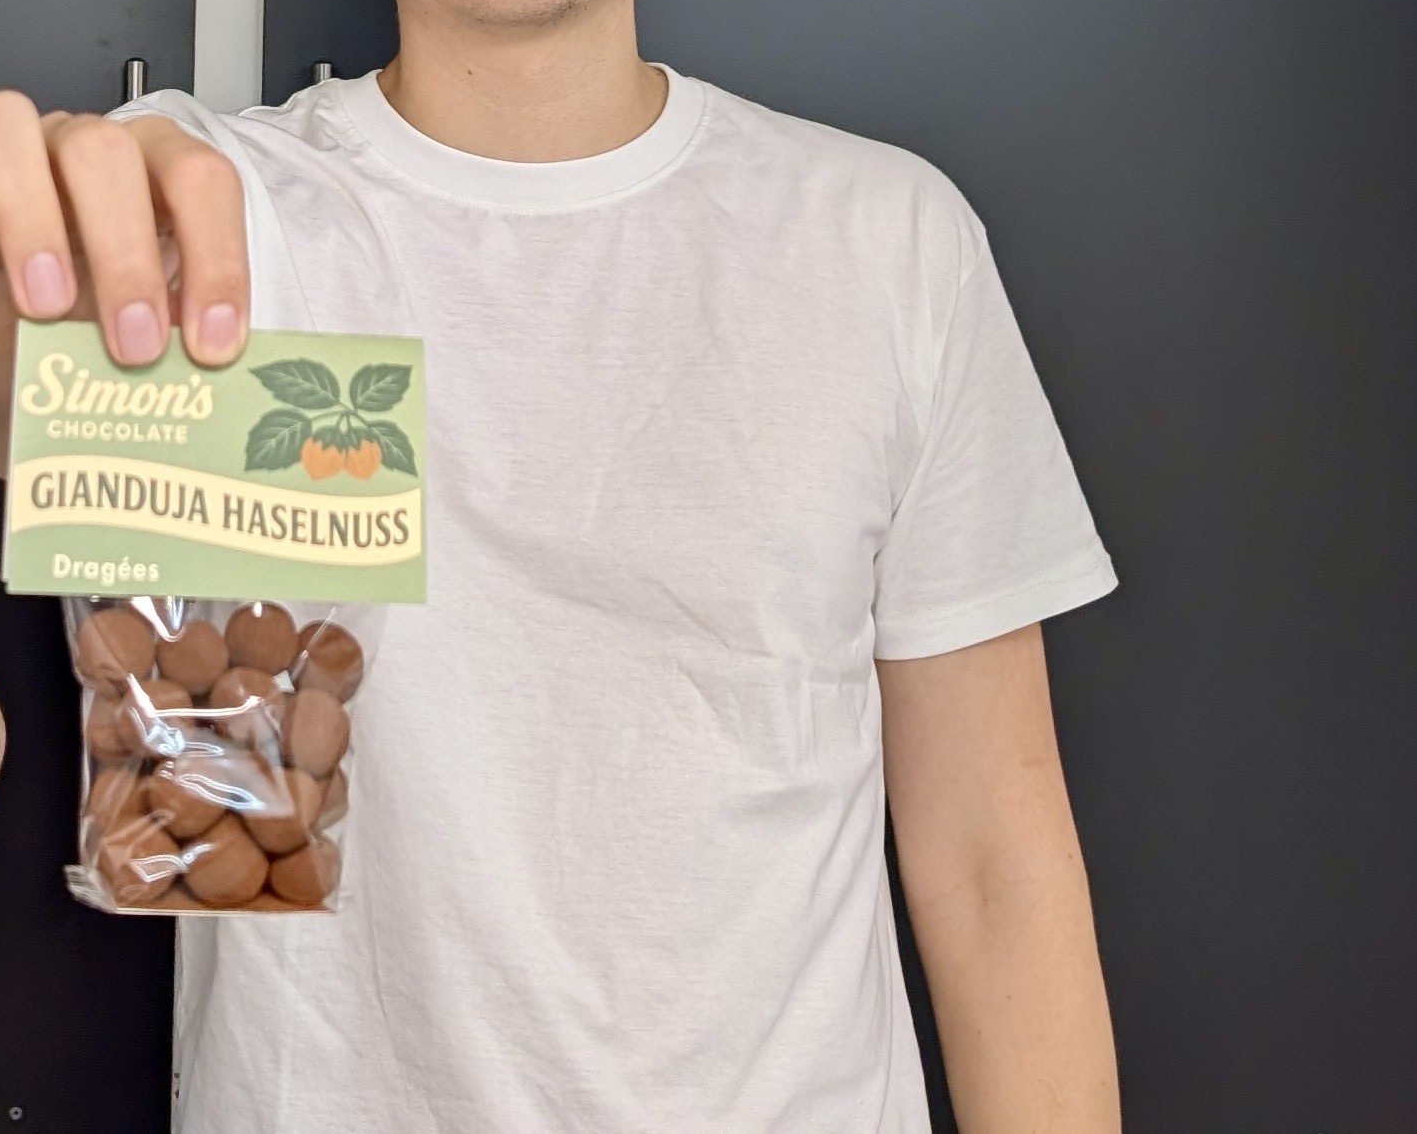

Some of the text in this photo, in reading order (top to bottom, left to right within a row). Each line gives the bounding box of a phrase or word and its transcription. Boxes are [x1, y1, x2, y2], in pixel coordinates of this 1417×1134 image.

[20, 352, 215, 420] Simon's
[46, 418, 188, 443] CHOCOLATE
[30, 470, 411, 549] GIANDUJA HASELNUSS
[52, 553, 160, 587] Dragées
